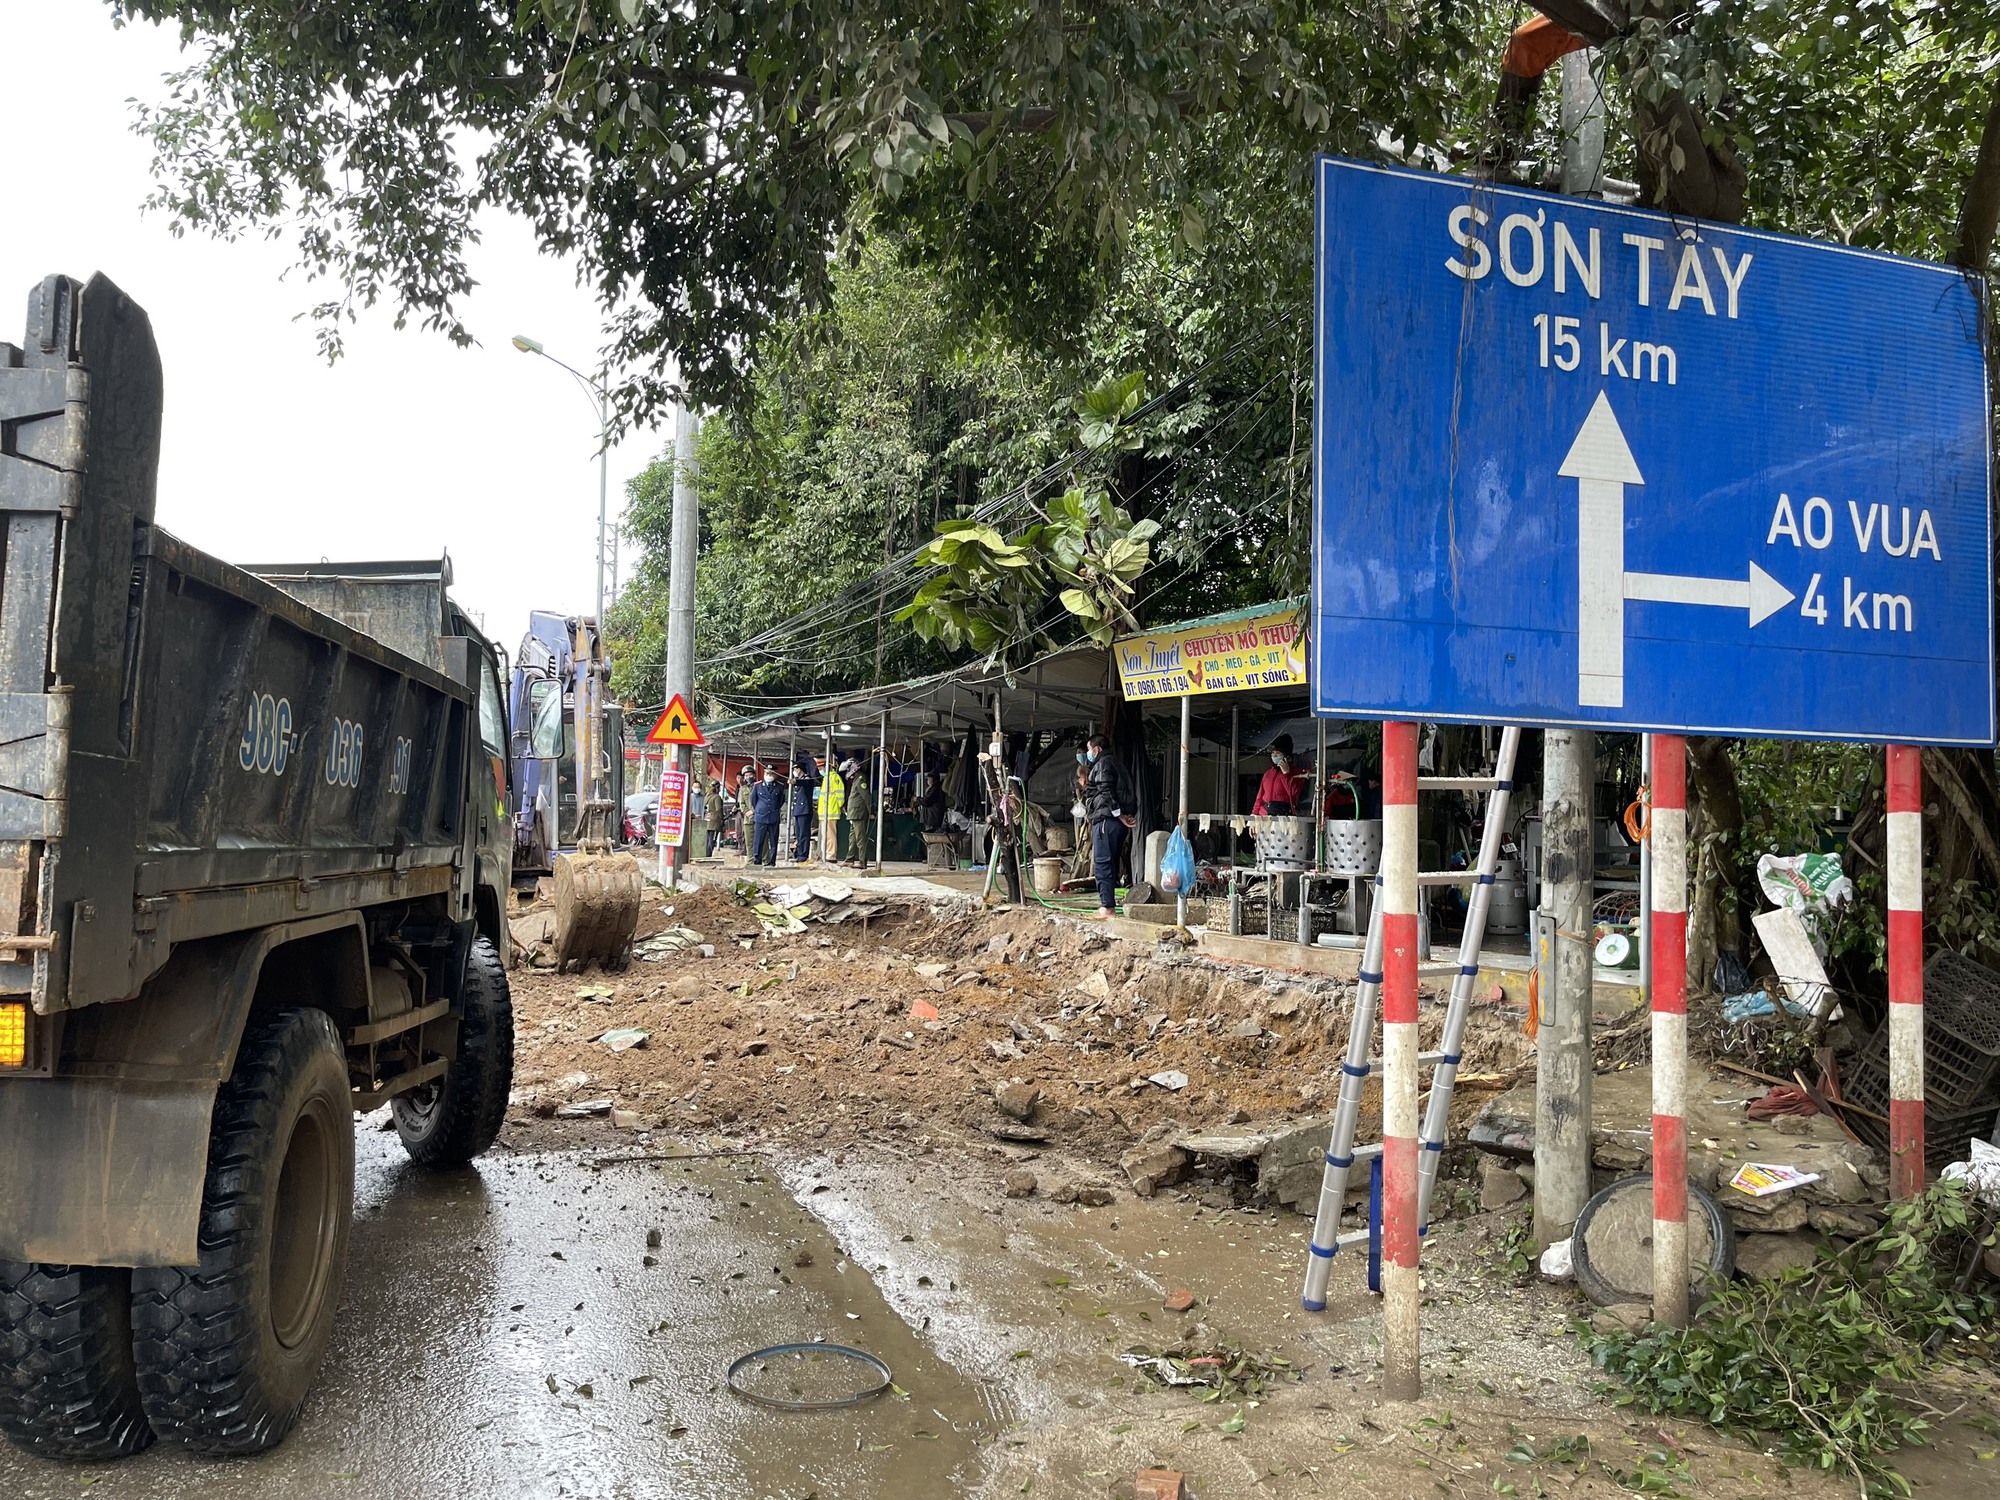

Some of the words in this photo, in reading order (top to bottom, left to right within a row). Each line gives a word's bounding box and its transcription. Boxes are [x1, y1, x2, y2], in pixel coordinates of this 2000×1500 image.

[1444, 205, 1600, 298] SƠN
[1622, 229, 1753, 319] TÂY
[1533, 313, 1580, 372] 15
[1600, 322, 1677, 386] km
[1766, 493, 1833, 549] AO
[1848, 500, 1942, 561] VUA
[1800, 573, 1828, 626] 4
[1843, 576, 1913, 632] km
[1184, 629, 1235, 658] CHUYÊN
[1137, 676, 1190, 695] 0968.166.194
[1262, 666, 1290, 684] SỐNG
